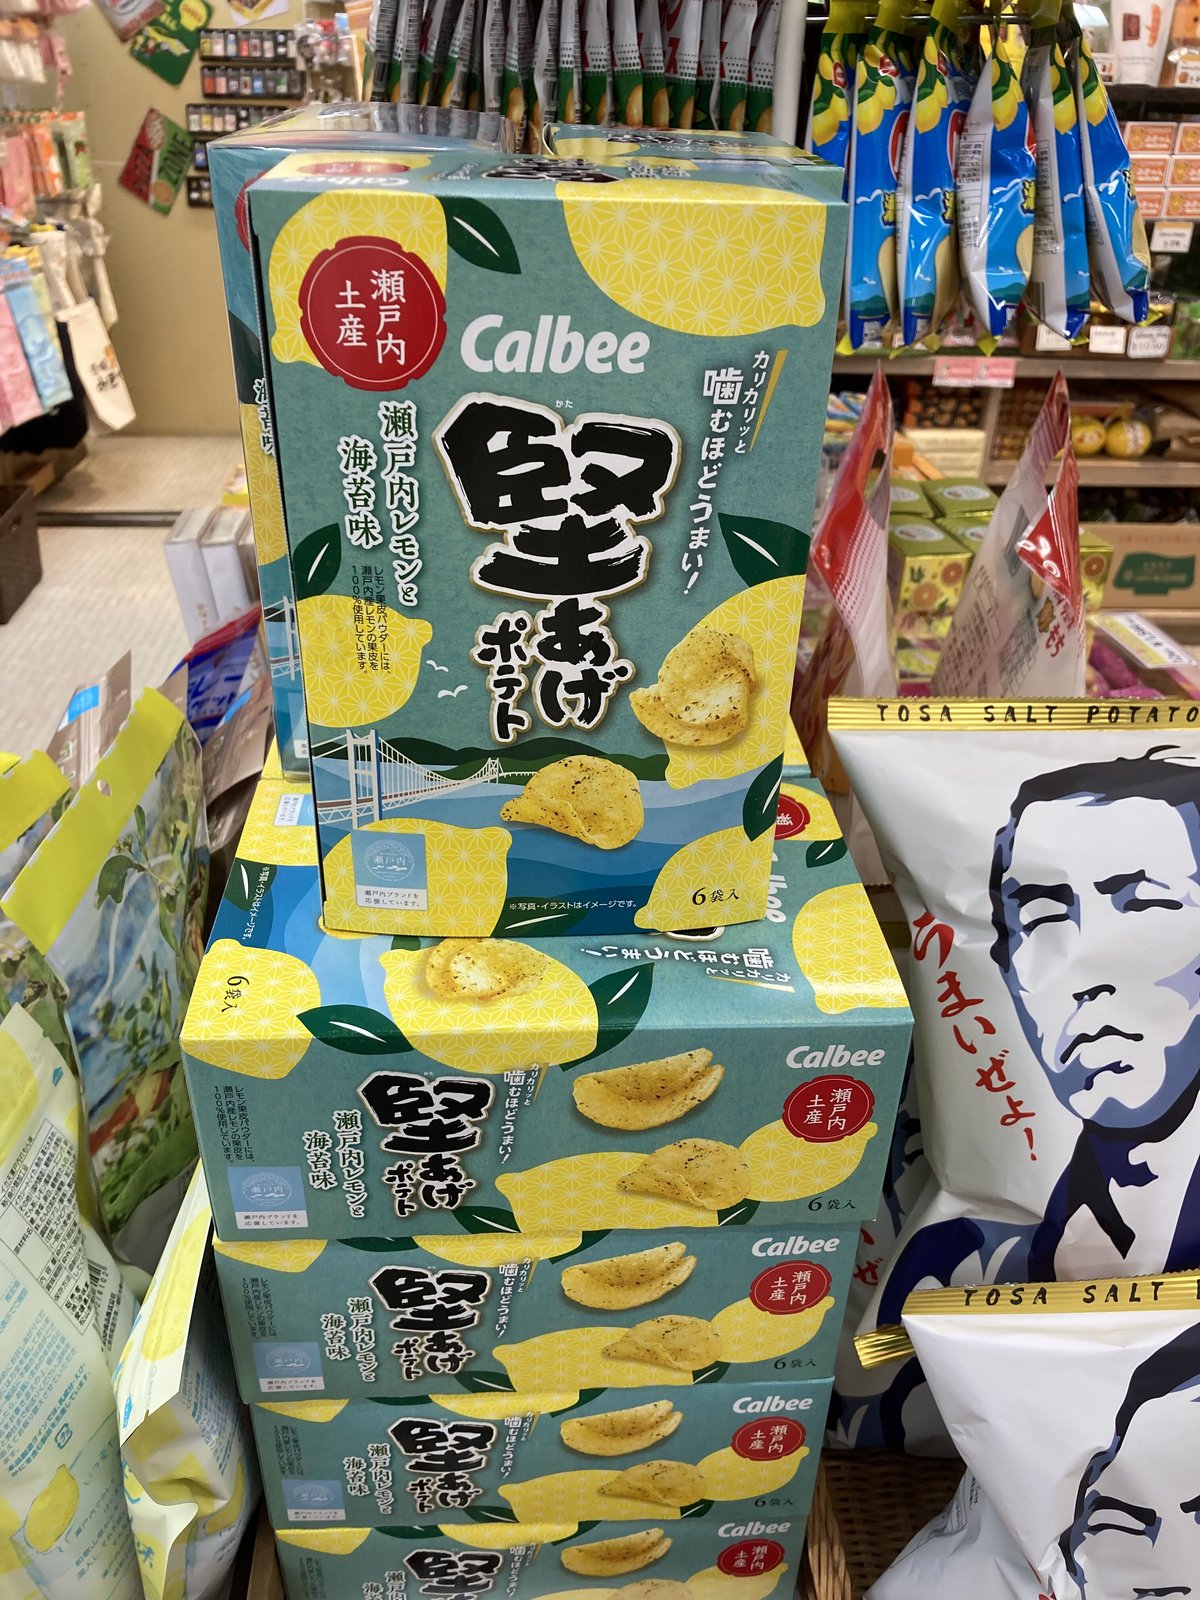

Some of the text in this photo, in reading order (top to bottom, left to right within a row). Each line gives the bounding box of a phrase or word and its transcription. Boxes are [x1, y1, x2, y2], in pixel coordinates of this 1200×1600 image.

[335, 280, 368, 347] 土産
[370, 269, 406, 366] 瀬戸内
[460, 315, 650, 374] Calbee
[555, 399, 573, 409] かた
[734, 350, 770, 454] カリカリッと
[338, 436, 381, 549] 海苔味
[380, 401, 421, 606] 瀬戸内レモンと
[361, 564, 379, 671] 瀬戸内産レモンの果皮を
[472, 612, 533, 744] ポテト
[876, 704, 953, 722] TOSA
[983, 704, 1059, 722] SALT
[509, 898, 637, 912] ※写真・イラストはイメージです。
[706, 968, 791, 983] カリカリッと
[786, 1044, 886, 1069] Calbee
[803, 1094, 826, 1125] 土産
[827, 1088, 852, 1131] 瀬戸内
[303, 1130, 337, 1190] 海苔味
[333, 1111, 365, 1218] 瀬戸内レモンと
[382, 1162, 419, 1217] ポテト
[751, 1236, 840, 1257] Calbee
[768, 1276, 789, 1301] 土産
[789, 1270, 811, 1305] 瀬戸内
[963, 1281, 1165, 1306] TOSA SALT
[321, 1313, 351, 1360] 海苔味
[348, 1297, 379, 1382] 瀬戸内レモンと
[391, 1337, 425, 1381] ポテト
[732, 1396, 813, 1414] Calbee
[749, 1429, 767, 1450] 土産
[768, 1424, 788, 1453] 瀬戸内
[343, 1456, 371, 1497] 海苔味
[407, 1475, 435, 1513] ポテト
[717, 1521, 791, 1538] Calbee
[404, 1549, 502, 1600] 堅
[751, 1545, 768, 1571] 瀬戸内
